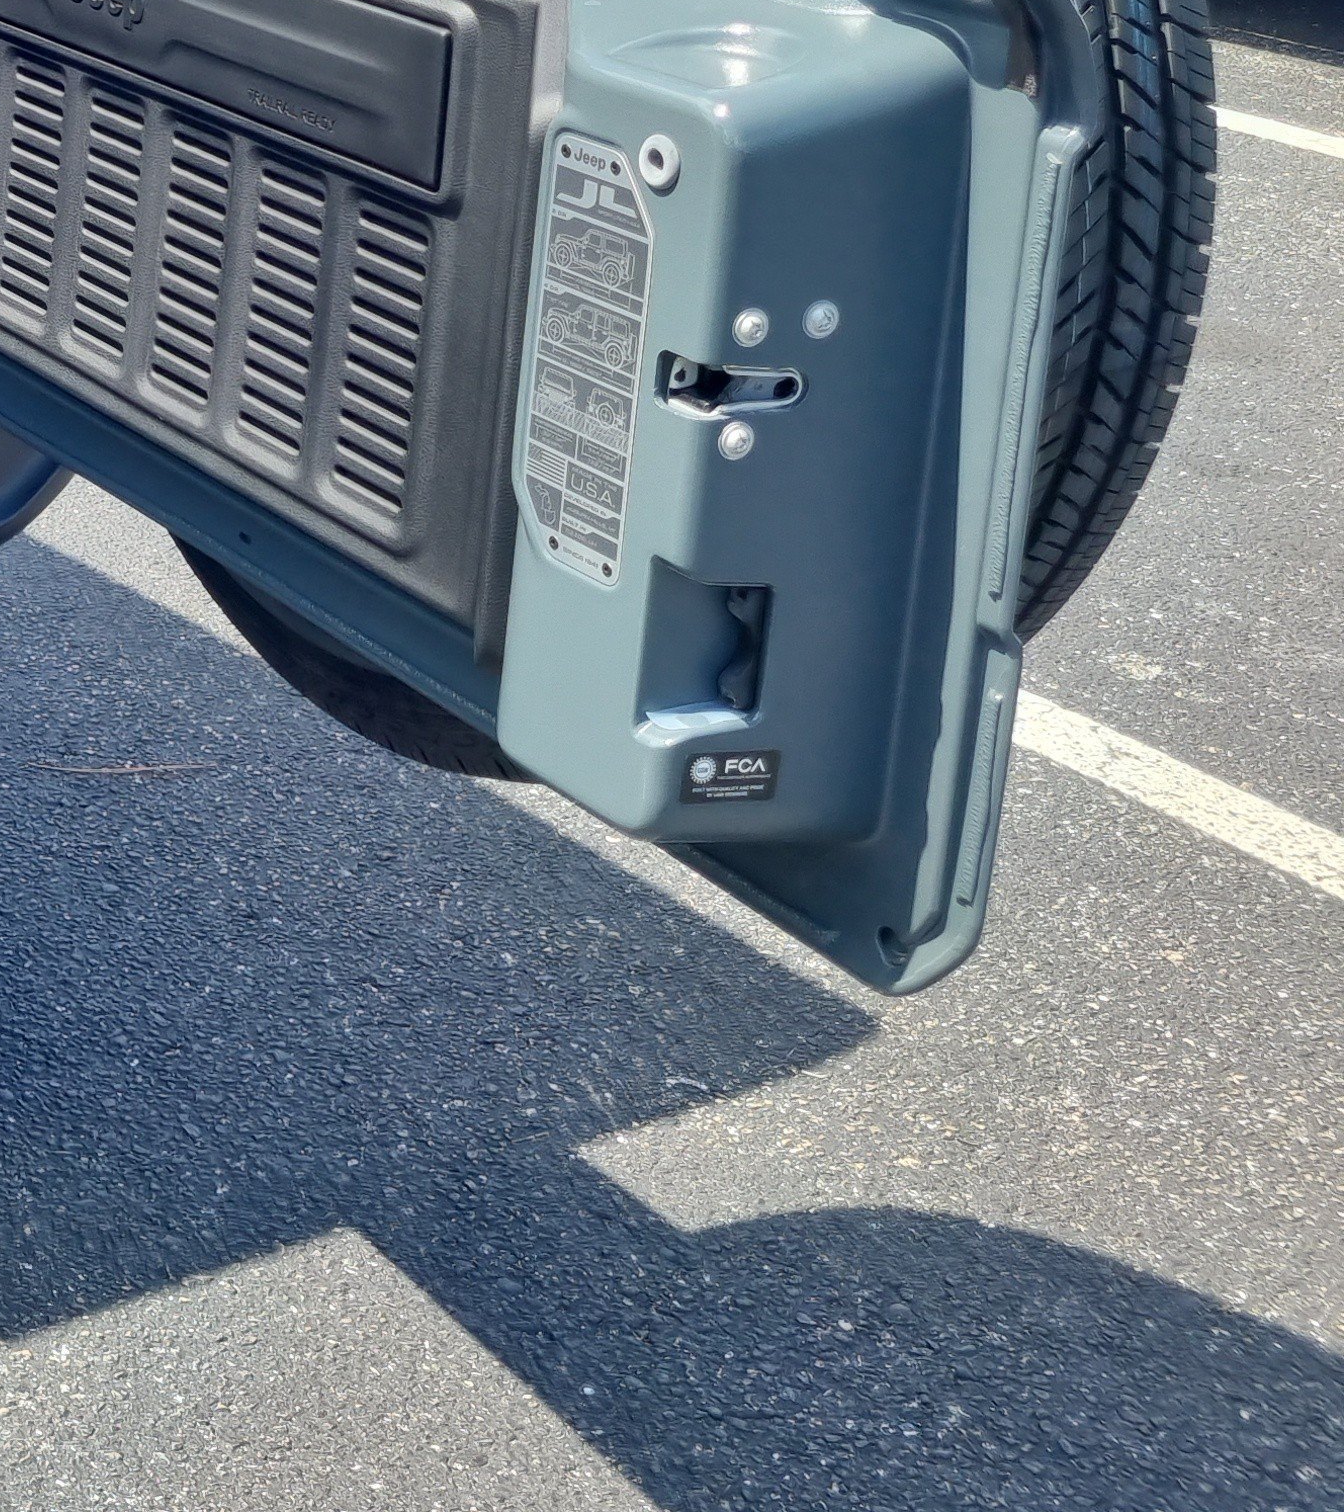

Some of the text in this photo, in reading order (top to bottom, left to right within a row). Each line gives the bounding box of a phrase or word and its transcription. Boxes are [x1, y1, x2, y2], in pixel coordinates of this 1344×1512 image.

[574, 148, 606, 171] Jeep
[556, 179, 637, 219] JL
[571, 473, 616, 508] U.S.A.
[724, 758, 766, 774] FCA
